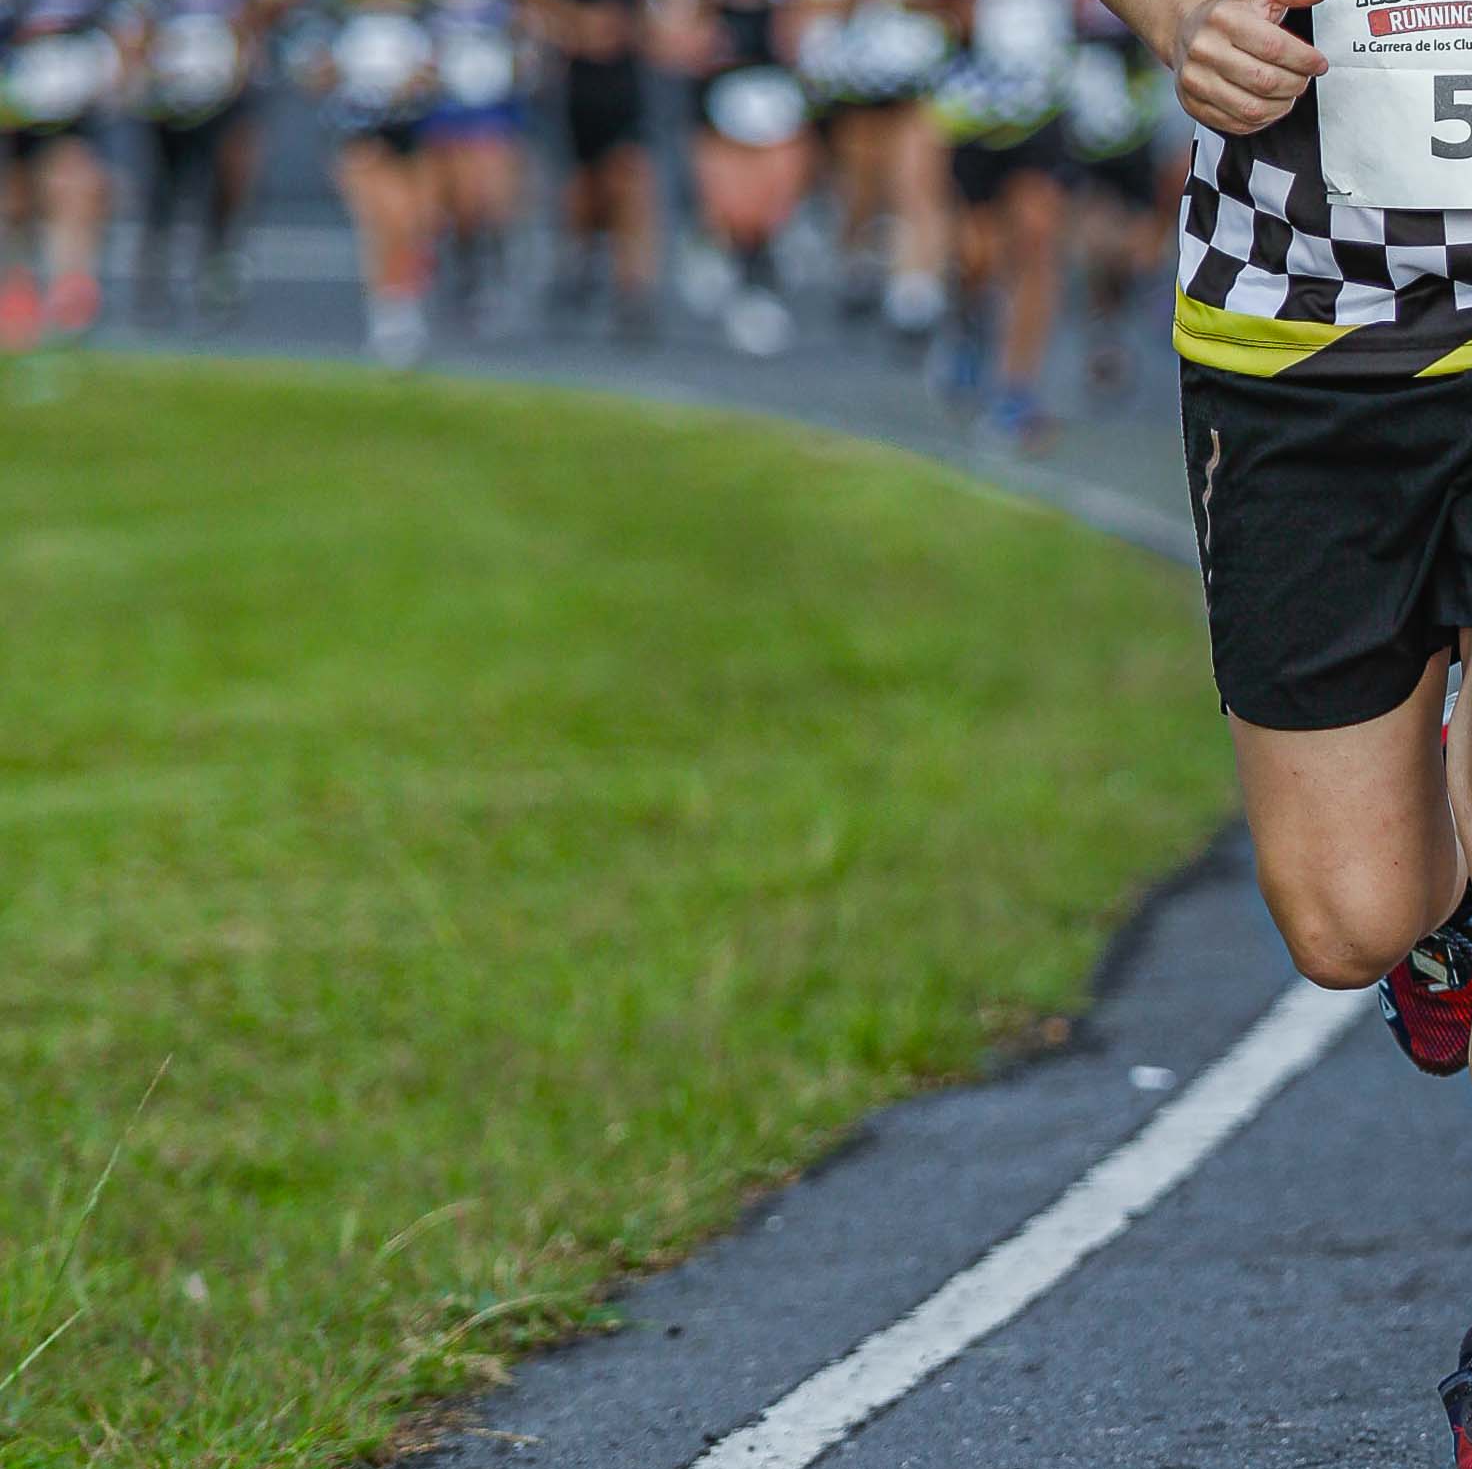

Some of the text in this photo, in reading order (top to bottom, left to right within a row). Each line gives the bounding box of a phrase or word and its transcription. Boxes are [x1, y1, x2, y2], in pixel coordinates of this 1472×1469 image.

[1353, 41, 1366, 52] La
[1368, 41, 1412, 52] Carrera
[1415, 39, 1431, 51] de
[1434, 39, 1451, 51] los
